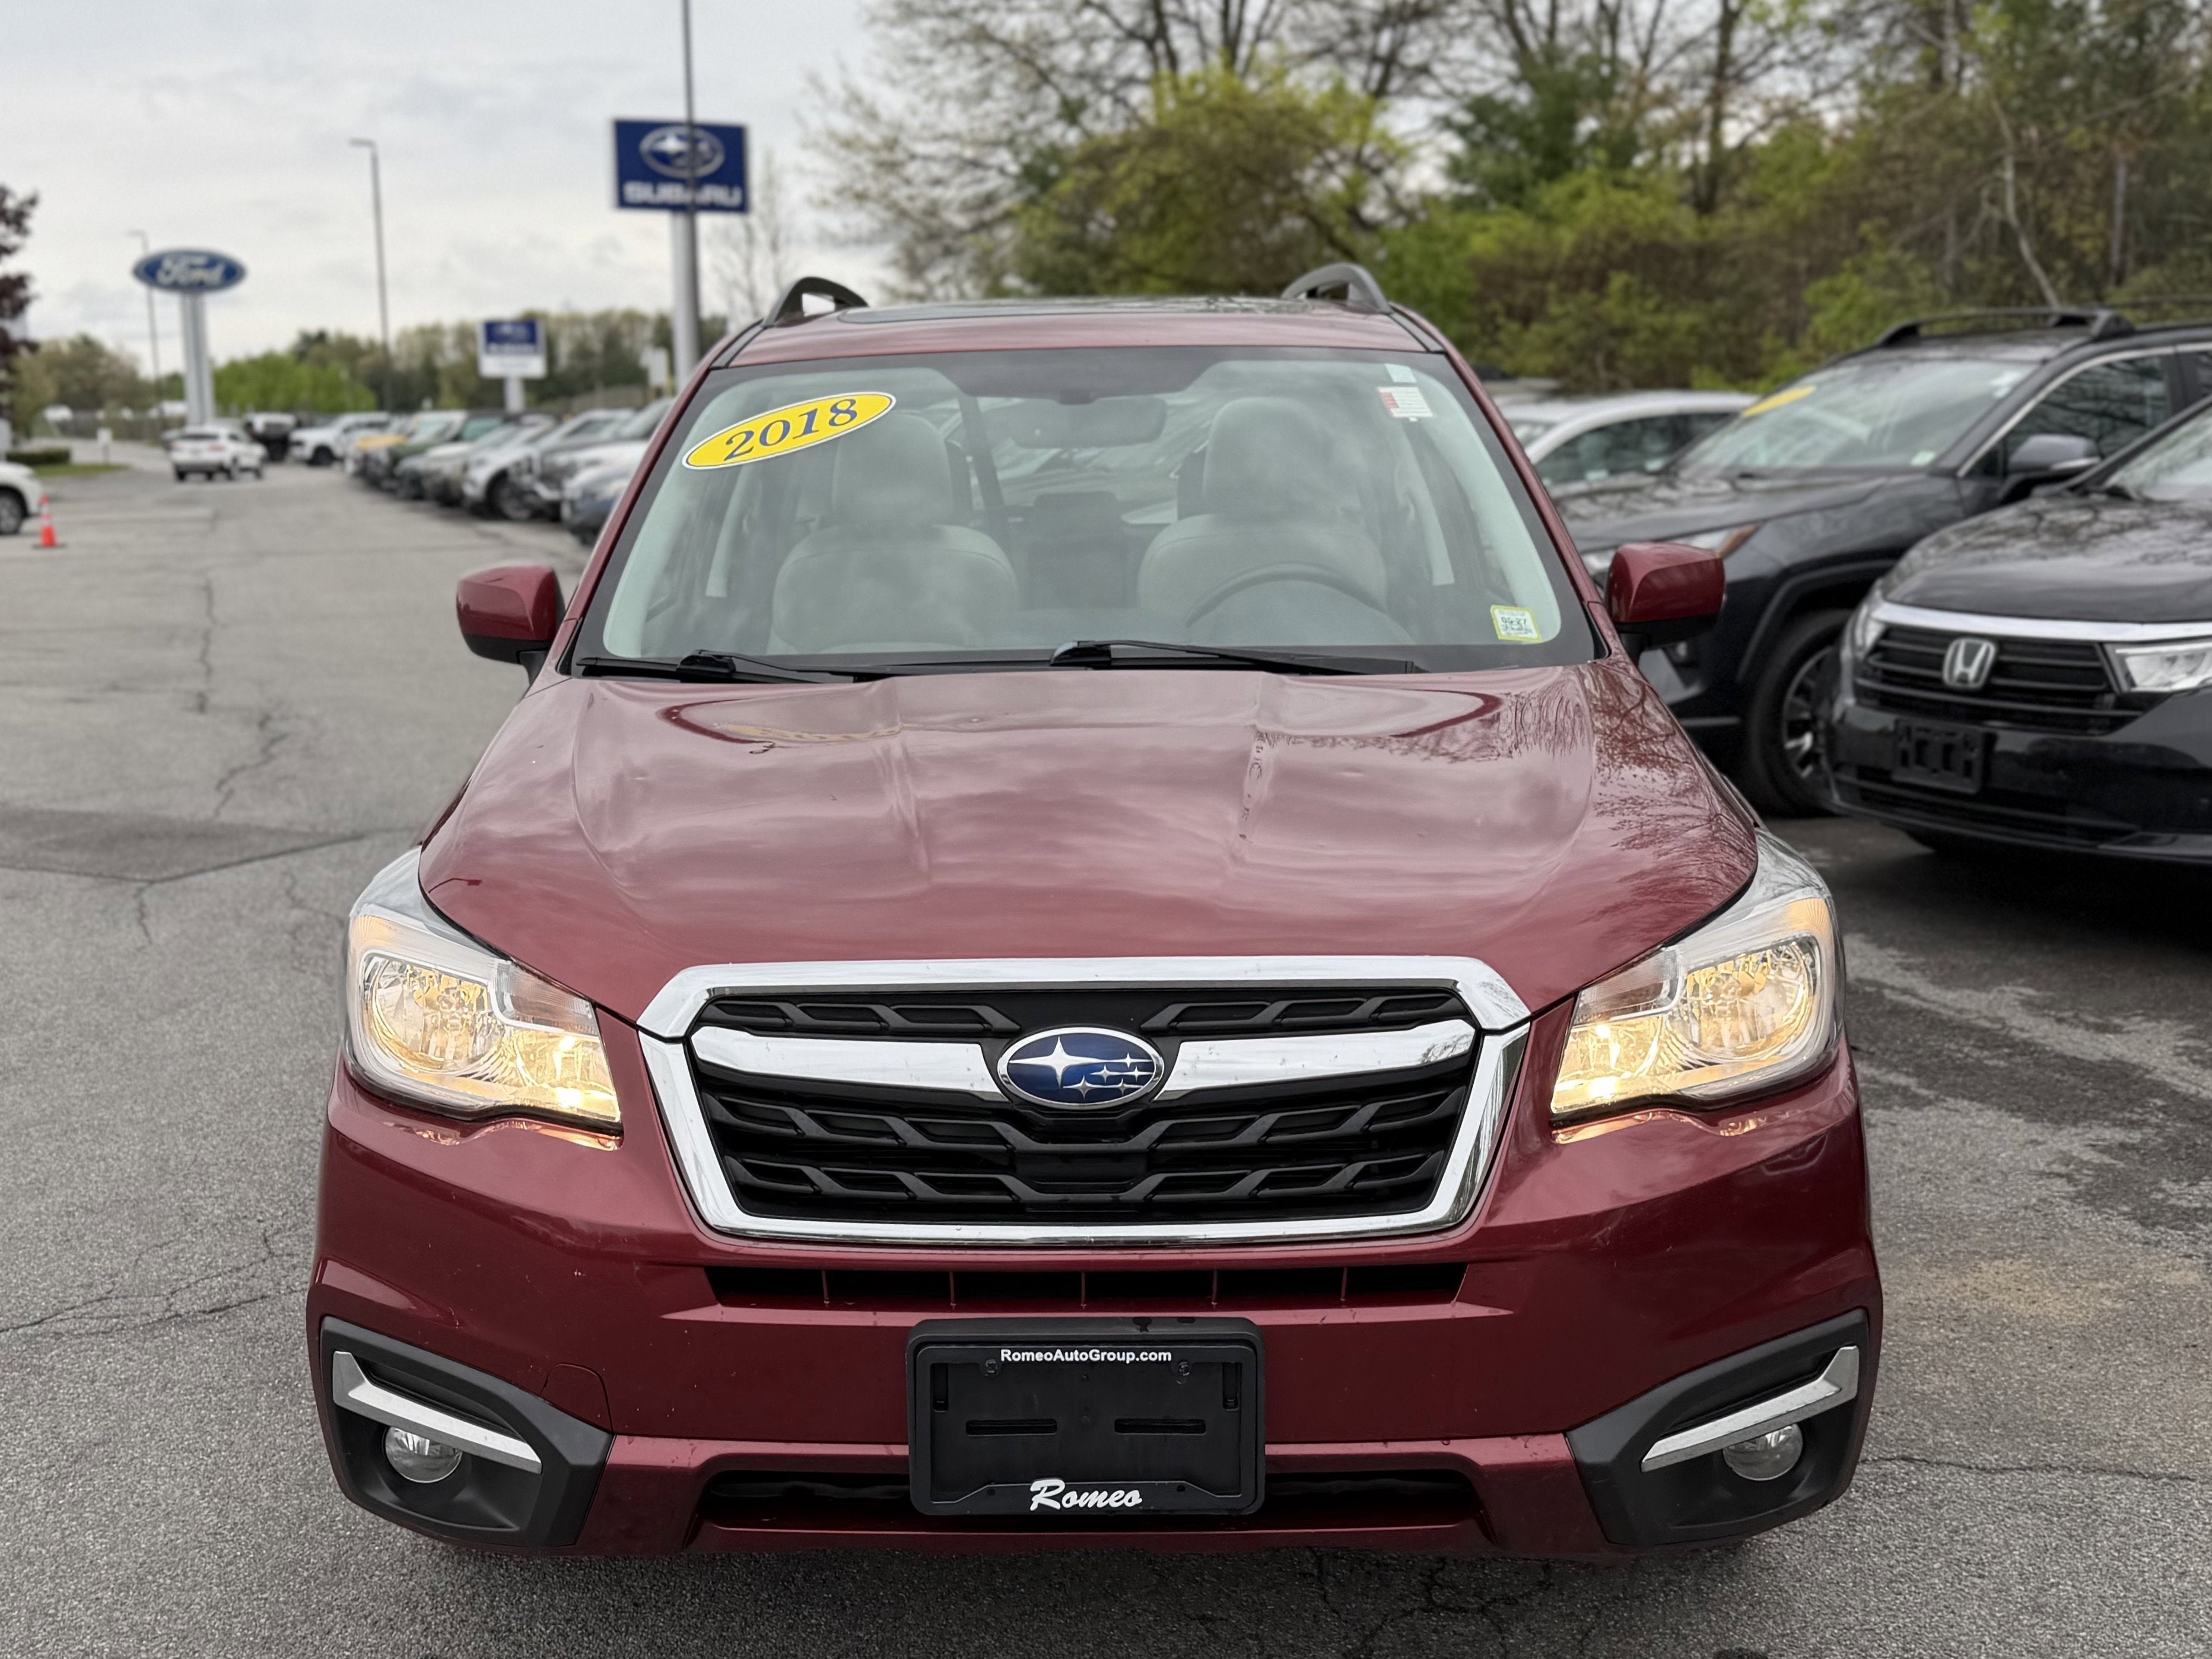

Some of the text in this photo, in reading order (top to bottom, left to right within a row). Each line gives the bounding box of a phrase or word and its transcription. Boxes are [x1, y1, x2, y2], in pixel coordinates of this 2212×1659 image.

[623, 180, 742, 207] SUBARU
[157, 256, 225, 286] Ford
[723, 398, 858, 462] 2018
[1000, 1349, 1172, 1364] RomeoAutoGroup.com
[1029, 1478, 1143, 1511] Romeo
